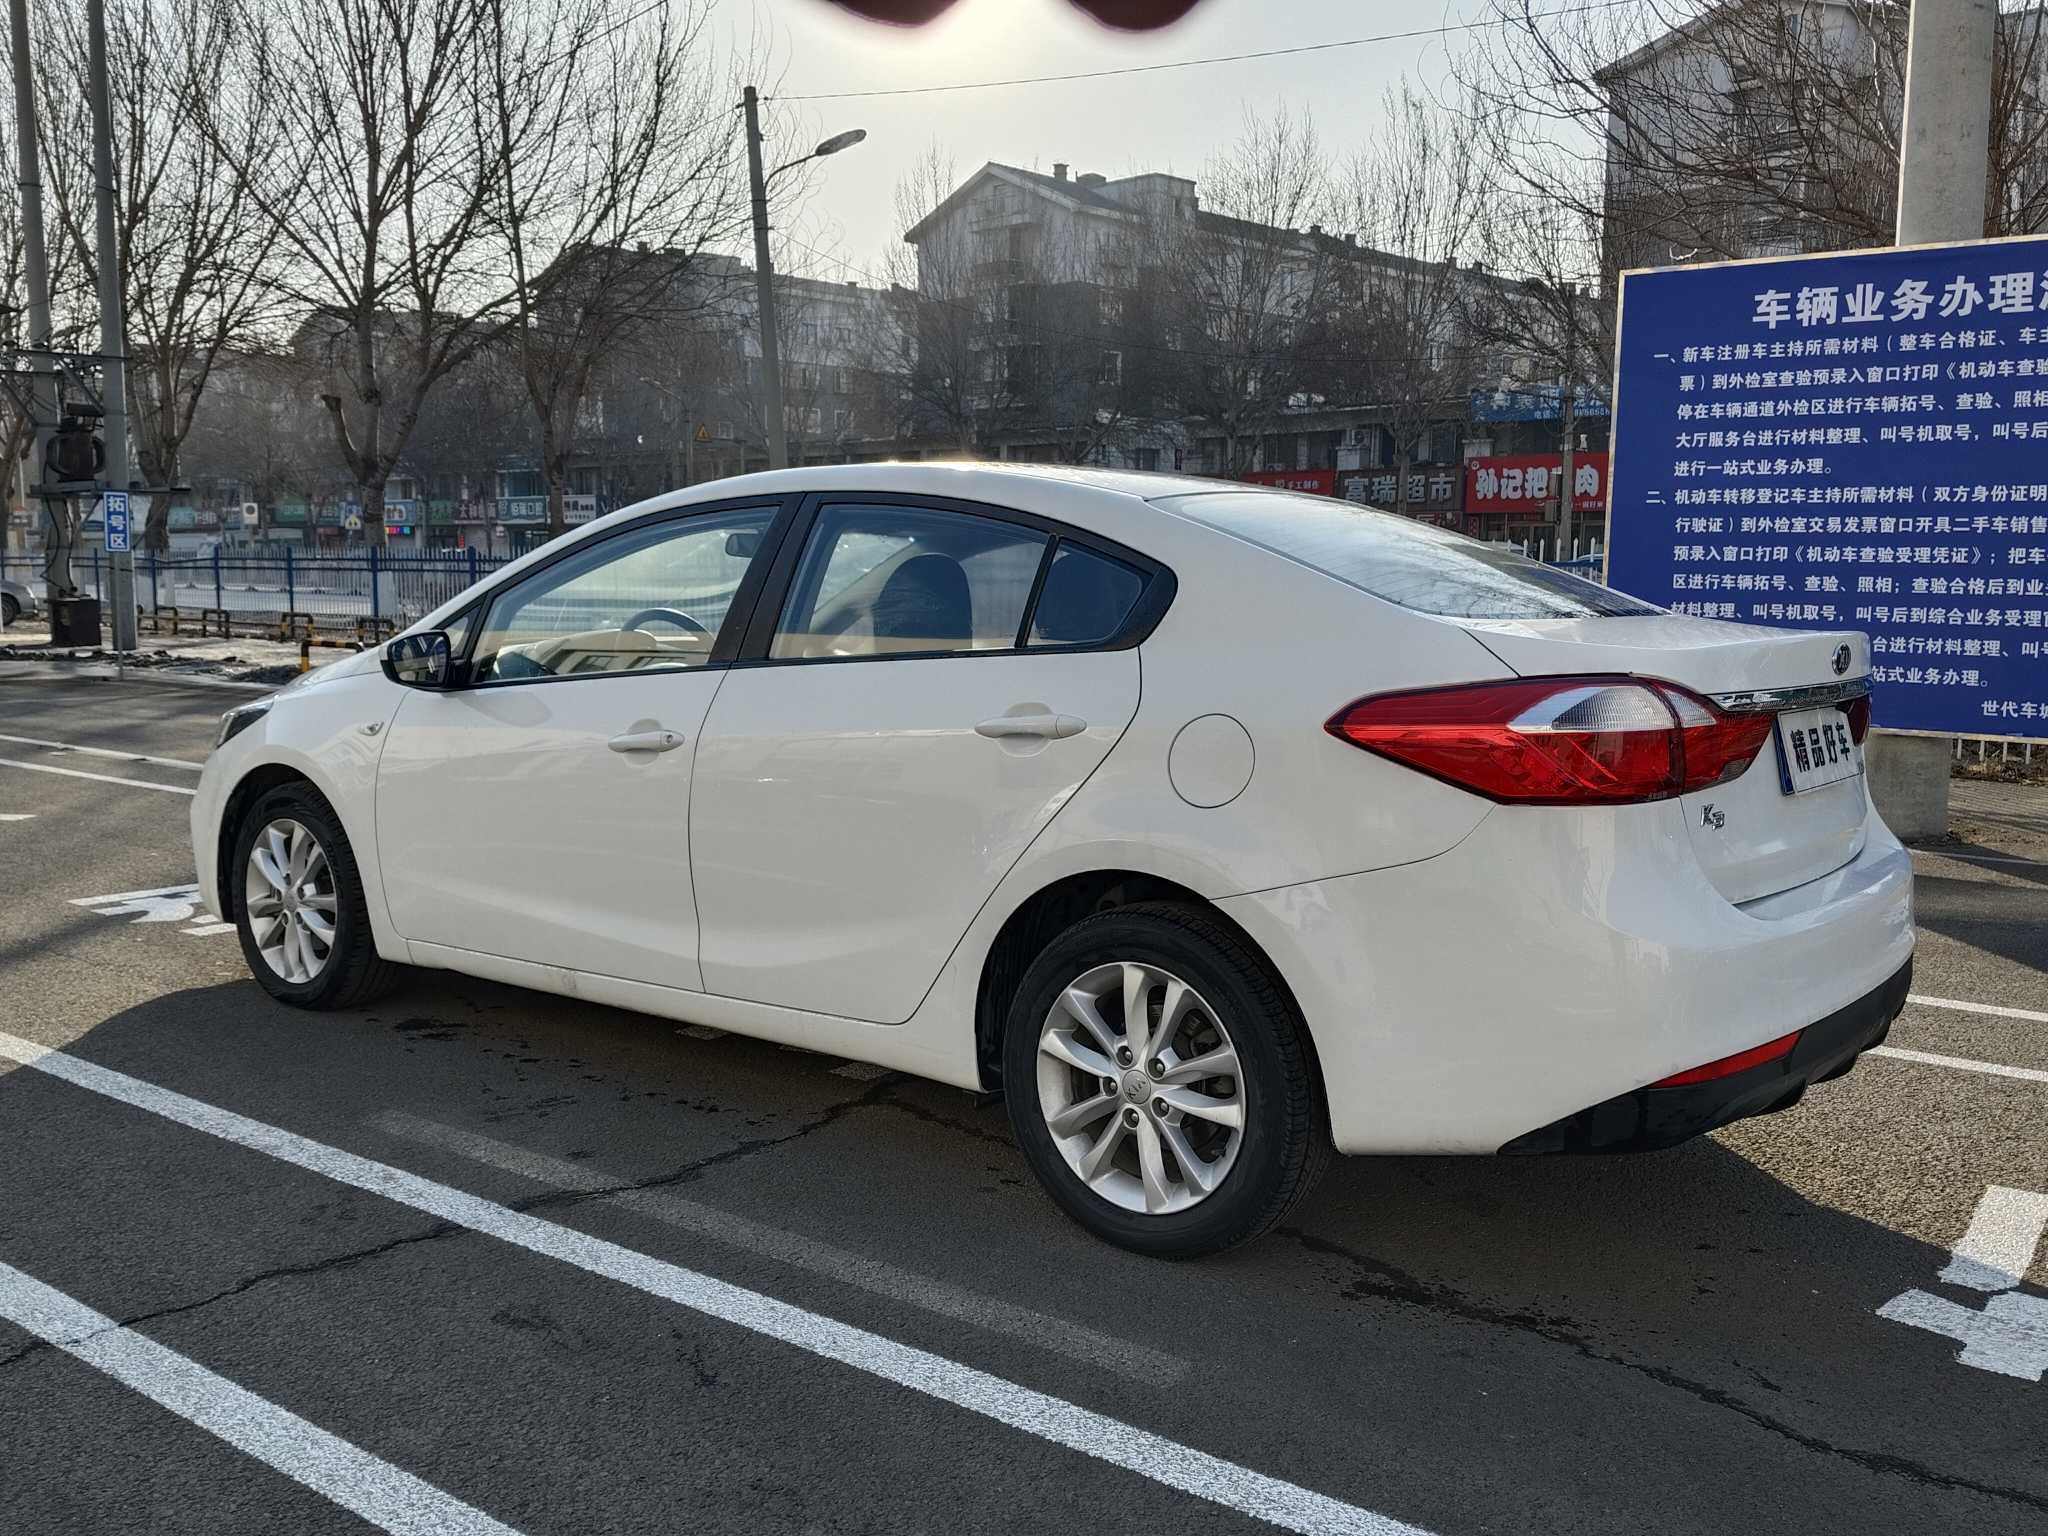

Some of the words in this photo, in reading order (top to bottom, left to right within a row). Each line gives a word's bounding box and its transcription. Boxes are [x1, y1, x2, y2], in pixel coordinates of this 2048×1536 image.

[1673, 457, 1832, 477] 进行一站式业务办理。
[1344, 473, 1456, 503] 富瑞超市
[1475, 464, 1600, 499] 孙记把肉
[108, 495, 126, 549] 拓号区
[1673, 545, 2048, 565] 预录入窗口打印《机动车查验受理凭证》；把车
[1672, 573, 2048, 597] 区进行车辆拓号、查验、照相；查验合格后到业
[1671, 601, 2048, 628] 材料整理、叫号机取号，叫号后到综合业务受理
[1790, 722, 1850, 773] 精品好车
[1700, 804, 1725, 830] K3
